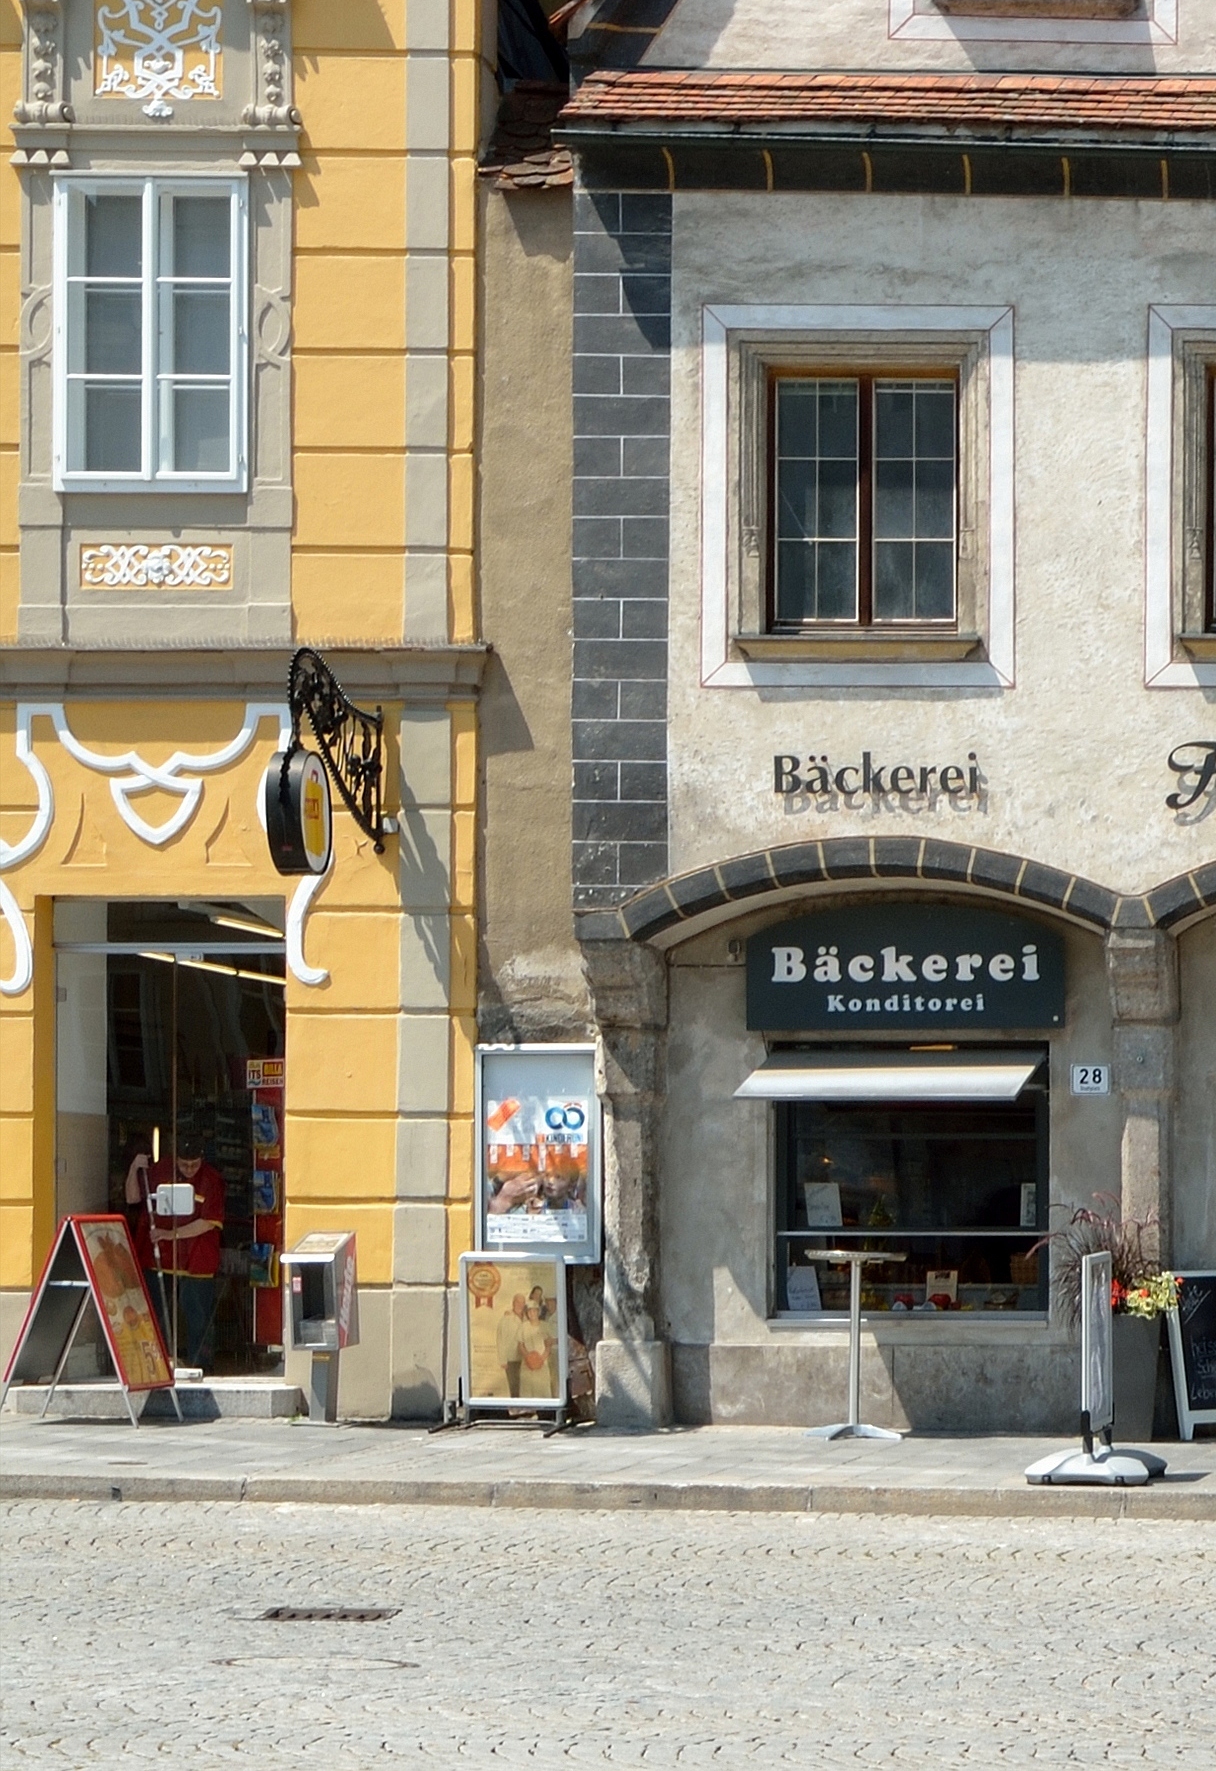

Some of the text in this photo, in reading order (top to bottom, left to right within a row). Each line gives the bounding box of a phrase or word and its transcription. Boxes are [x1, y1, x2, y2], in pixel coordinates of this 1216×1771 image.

[773, 751, 981, 795] Bäckerei
[771, 944, 1041, 983] Bäckerei
[826, 993, 986, 1013] Konditorei
[1079, 1068, 1102, 1084] 28
